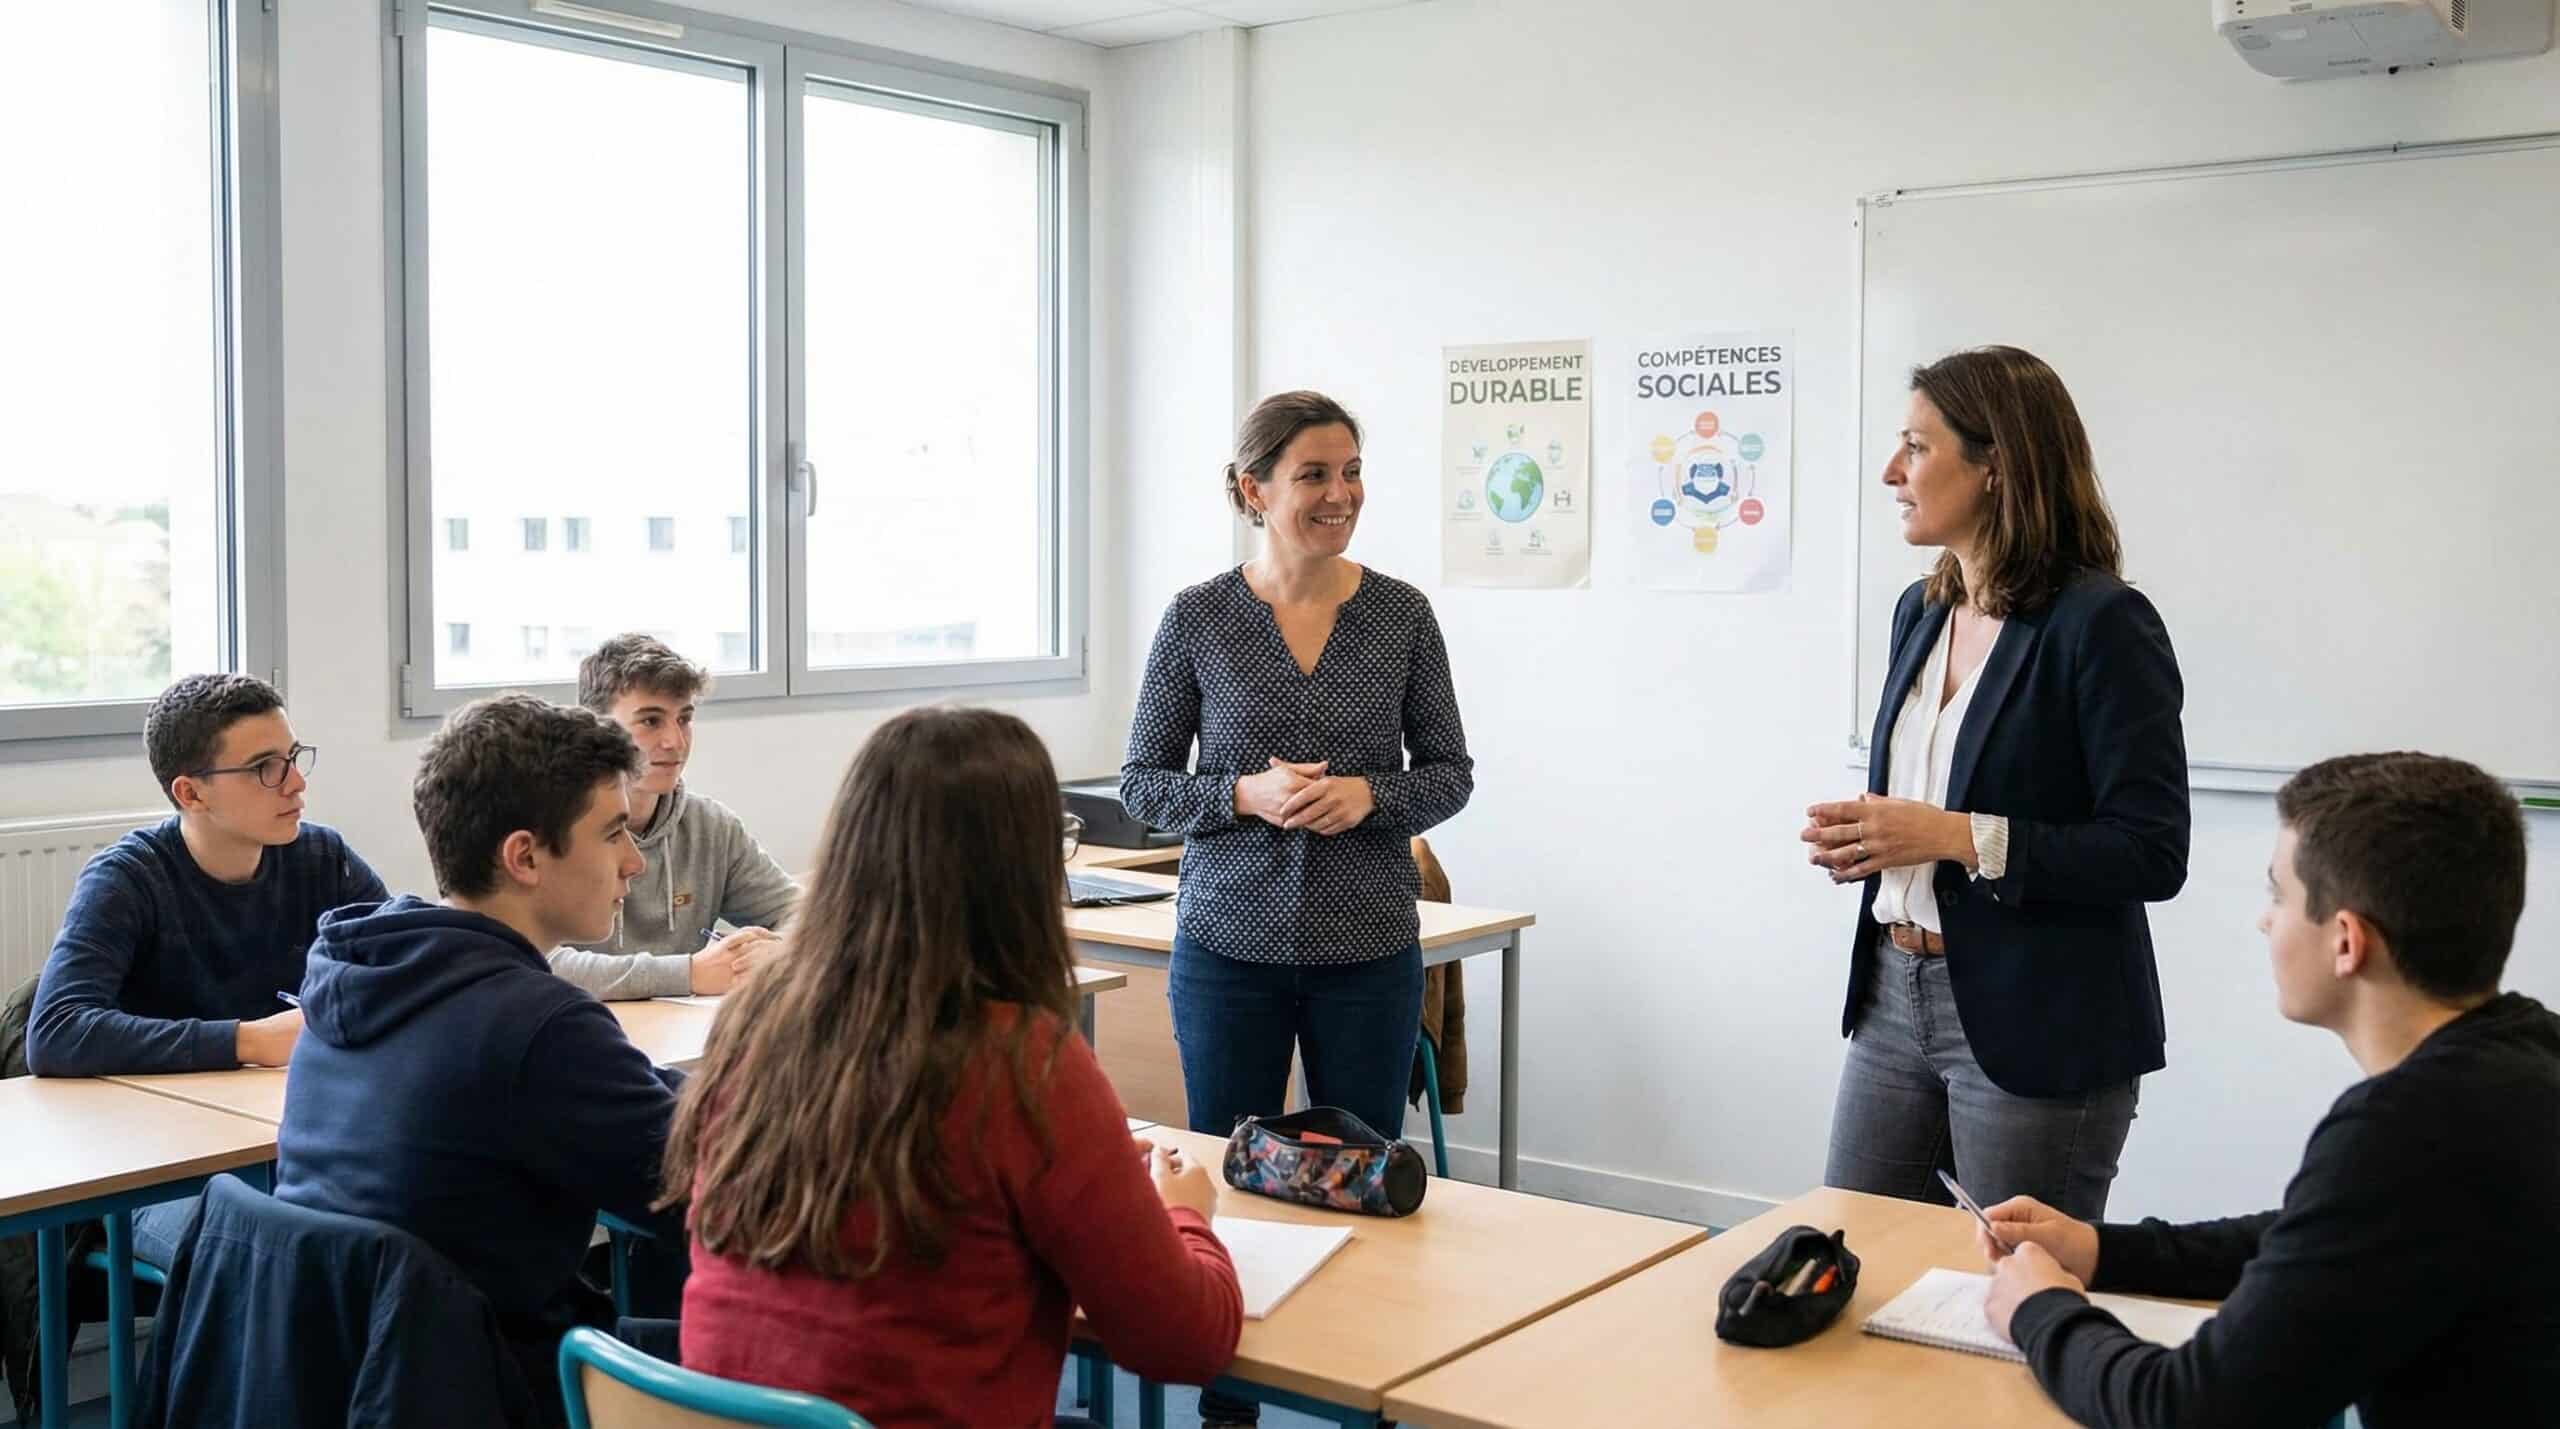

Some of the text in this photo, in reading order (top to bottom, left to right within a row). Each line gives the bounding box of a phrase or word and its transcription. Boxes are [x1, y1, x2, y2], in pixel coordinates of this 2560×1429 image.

[1638, 345, 1782, 367] COMPÉTENCES
[1450, 377, 1583, 404] DURABLE
[1637, 371, 1782, 398] SOCIALES
